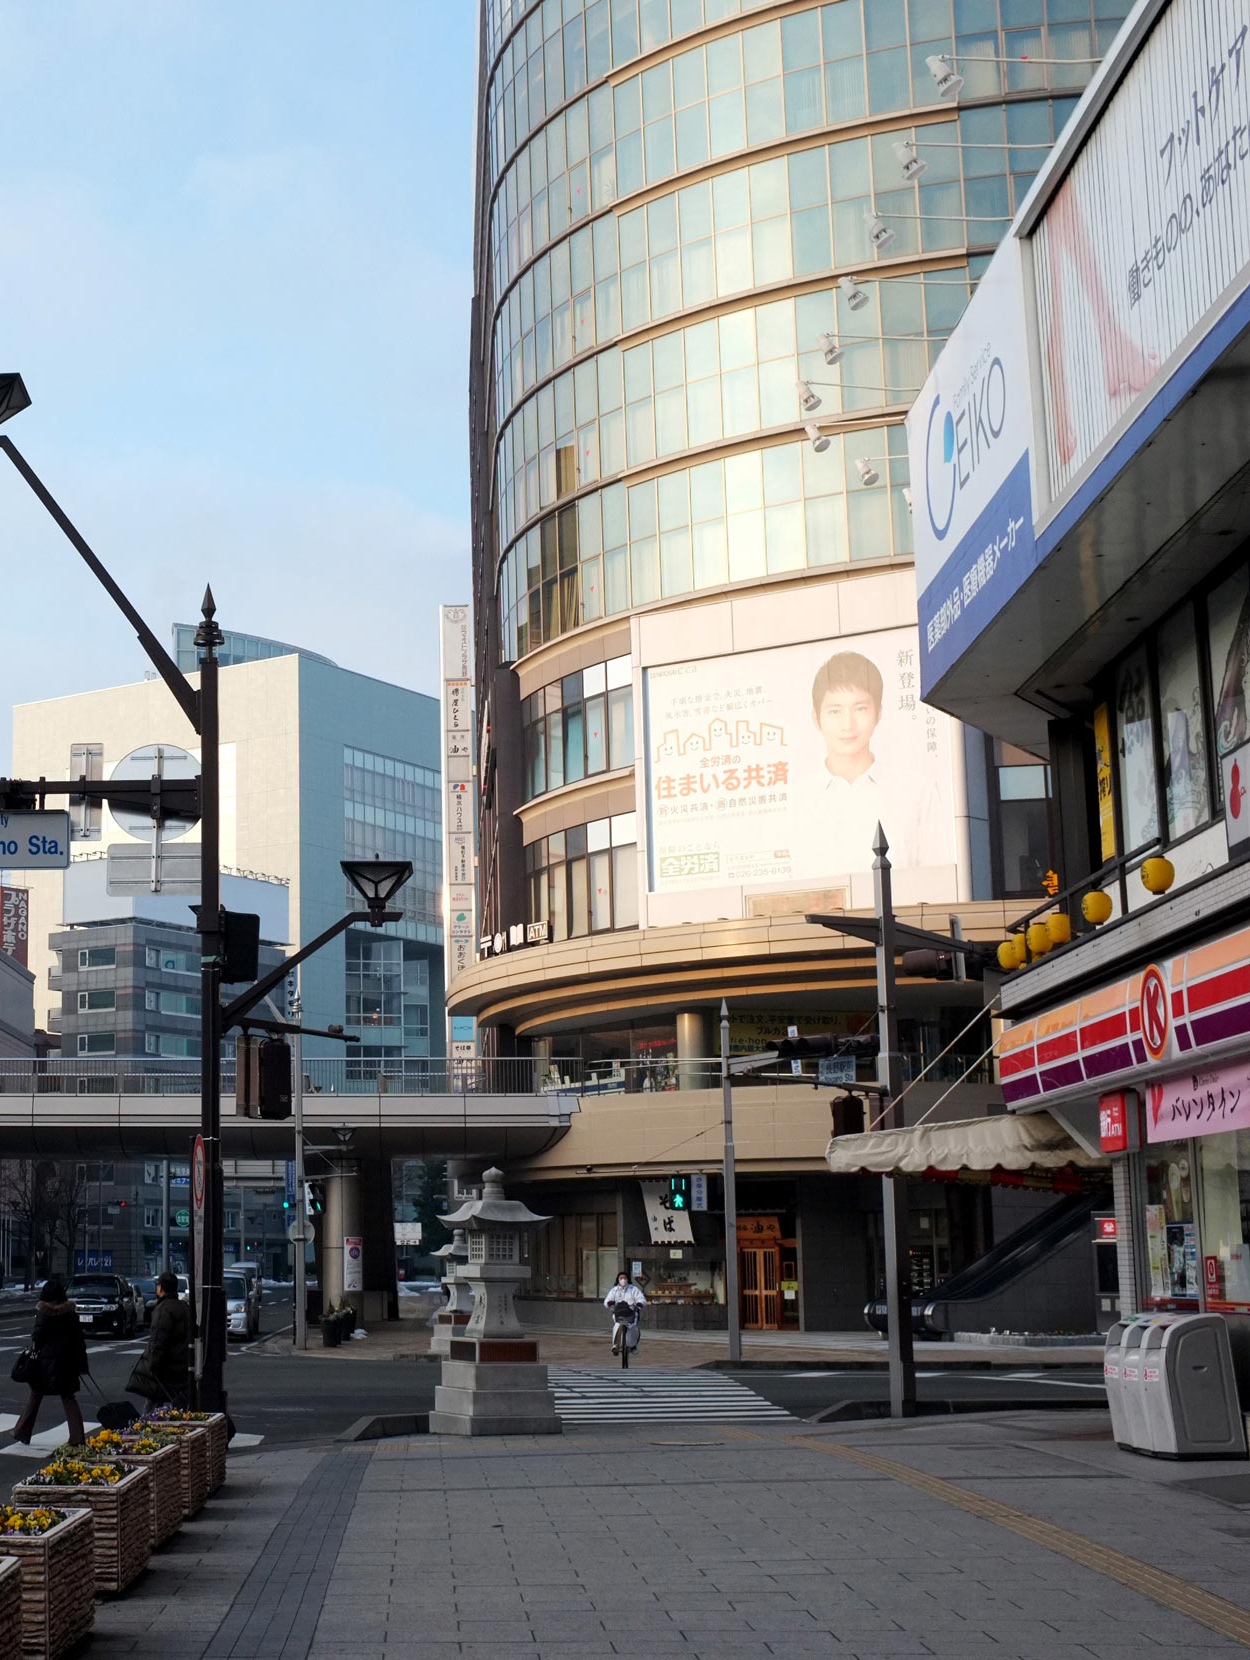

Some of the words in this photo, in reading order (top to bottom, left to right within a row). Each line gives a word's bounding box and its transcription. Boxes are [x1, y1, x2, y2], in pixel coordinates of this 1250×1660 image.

[1160, 24, 1248, 188] フットケア
[1128, 122, 1250, 310] 働きものの、あなた
[896, 648, 917, 720] 新登場。
[699, 754, 741, 768] 全労済の
[655, 760, 789, 800] 住まいる共済
[28, 835, 64, 856] Sta.
[661, 853, 719, 877] 全労済
[18, 892, 27, 940] NAGANO
[529, 924, 546, 940] ATM
[1171, 1086, 1241, 1122] バレンタイン
[659, 1193, 676, 1232] そば
[77, 1255, 112, 1267] レパレ21
